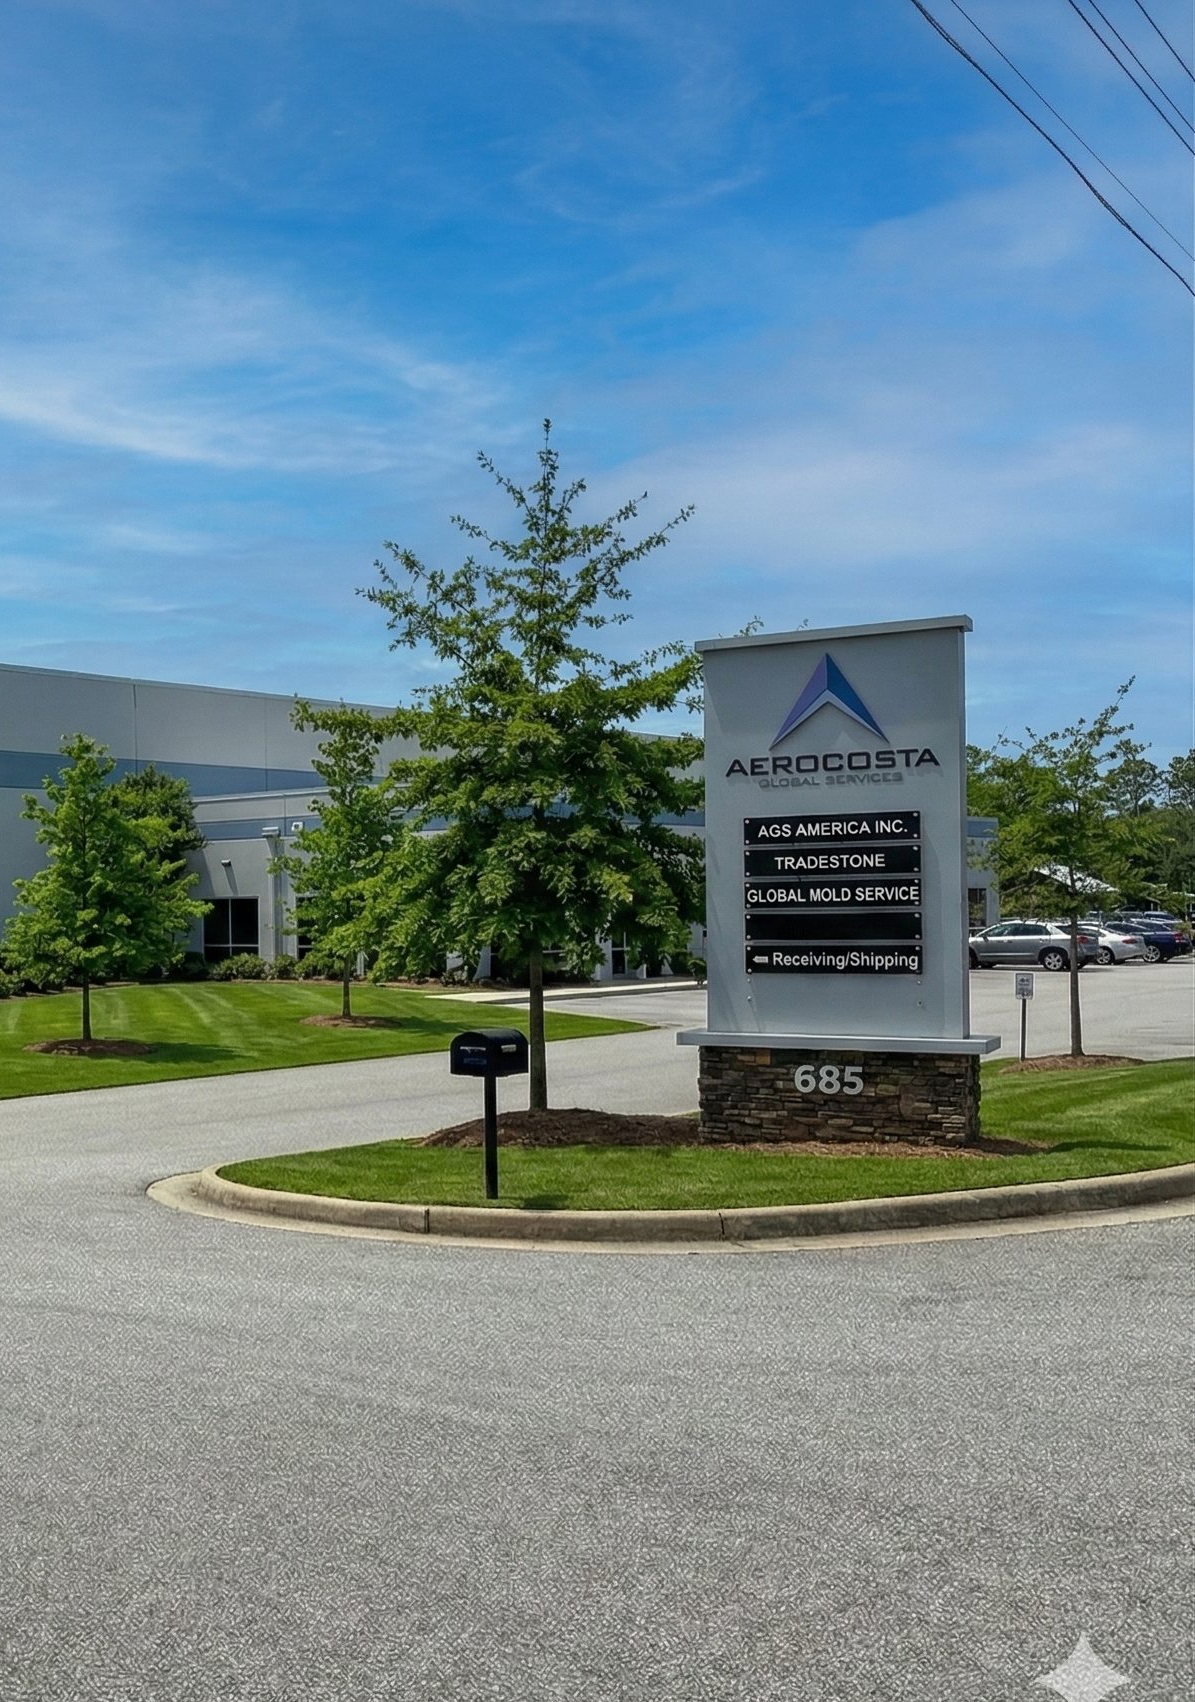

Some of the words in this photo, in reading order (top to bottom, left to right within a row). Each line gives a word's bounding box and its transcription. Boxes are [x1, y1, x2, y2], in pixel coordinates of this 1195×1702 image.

[725, 748, 940, 777] AEROCOSTA
[758, 776, 820, 789] GLOBAL
[825, 772, 904, 786] SERVICES
[758, 824, 792, 838] AGS
[795, 820, 871, 837] AMERICA
[875, 819, 908, 834] INC.
[774, 853, 886, 870] TRADESTONE
[747, 888, 806, 903] GLOBAL
[809, 887, 852, 902] MOLD
[855, 886, 920, 901] SERVICE
[772, 951, 919, 971] Receiving/Shipping
[794, 1064, 864, 1095] 685
